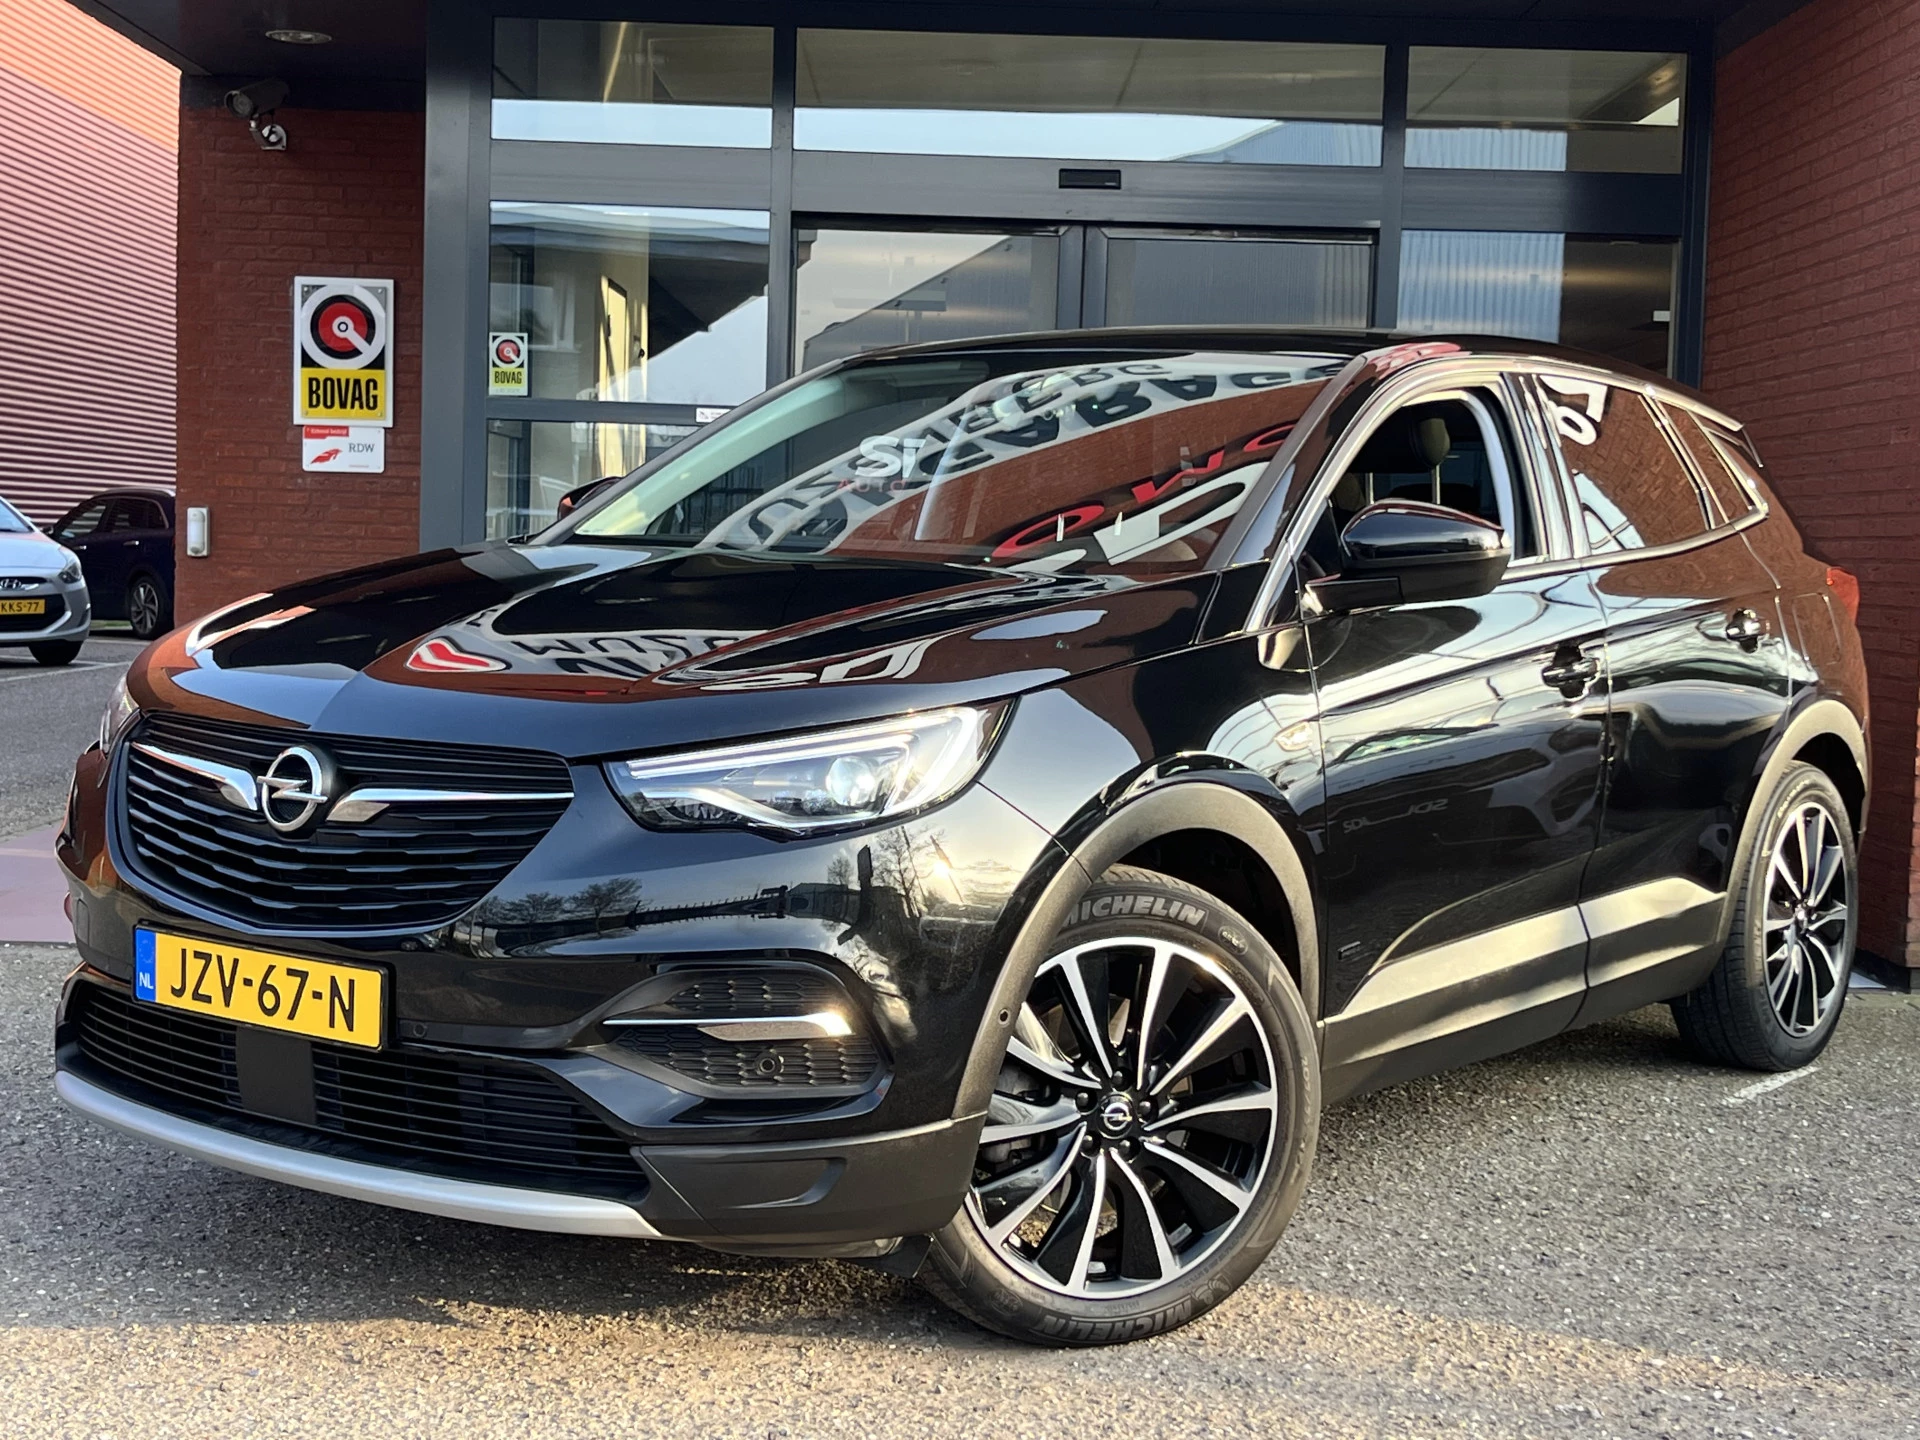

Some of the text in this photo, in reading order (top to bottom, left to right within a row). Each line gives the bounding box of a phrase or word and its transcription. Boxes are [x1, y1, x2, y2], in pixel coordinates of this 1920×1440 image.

[494, 370, 522, 384] BOVAG
[307, 377, 378, 411] BOVAG
[348, 443, 376, 453] RDW
[1, 602, 40, 613] KKS-77
[139, 971, 154, 990] NL
[170, 948, 355, 1033] JZV-67-N
[1034, 1300, 1193, 1342] MICHELIN
